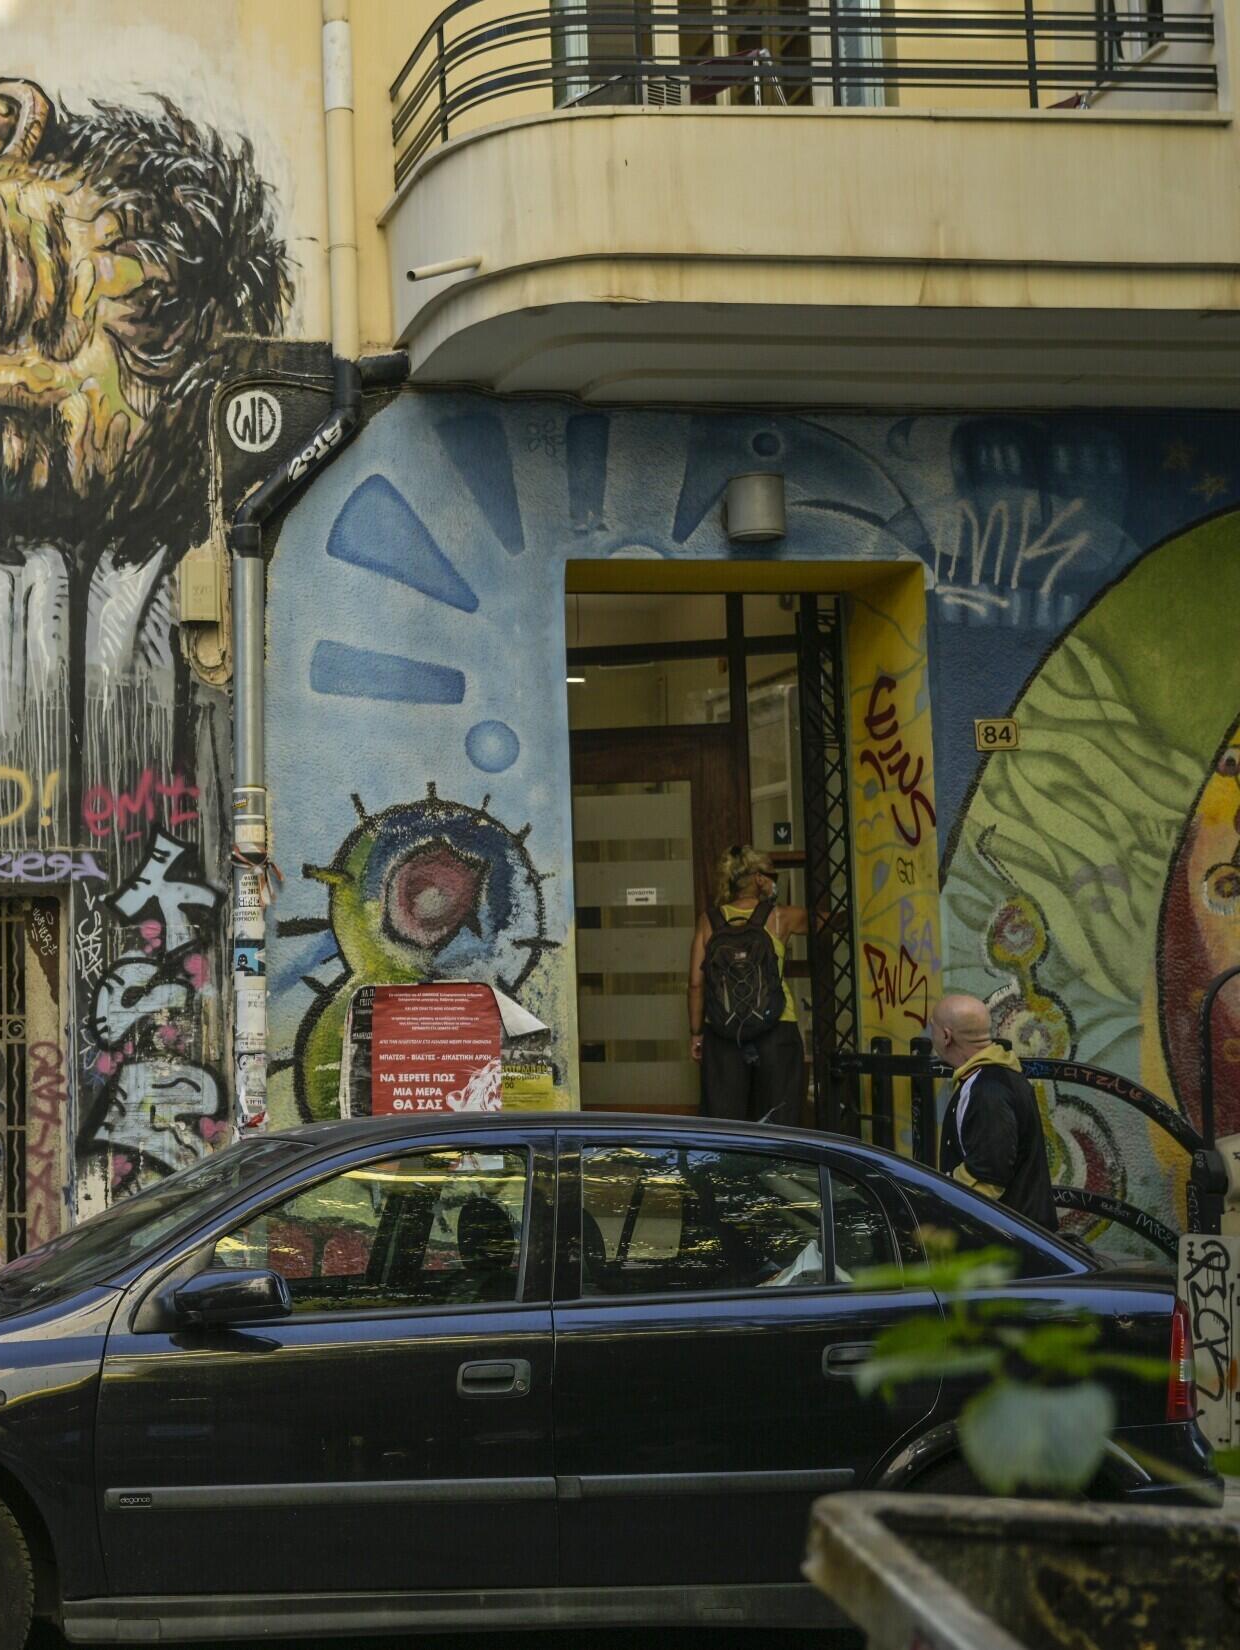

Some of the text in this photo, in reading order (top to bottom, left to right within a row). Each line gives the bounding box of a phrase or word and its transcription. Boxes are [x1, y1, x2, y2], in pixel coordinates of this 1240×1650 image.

[983, 725, 1013, 745] 84
[380, 1073, 455, 1083] ΝΑ ΞΕΡΕΤΕ ΠΩΣ
[393, 1087, 443, 1097] ΜΙΑ ΜΕΡΑ
[393, 1099, 443, 1110] ΘΑ ΣΑΣ
